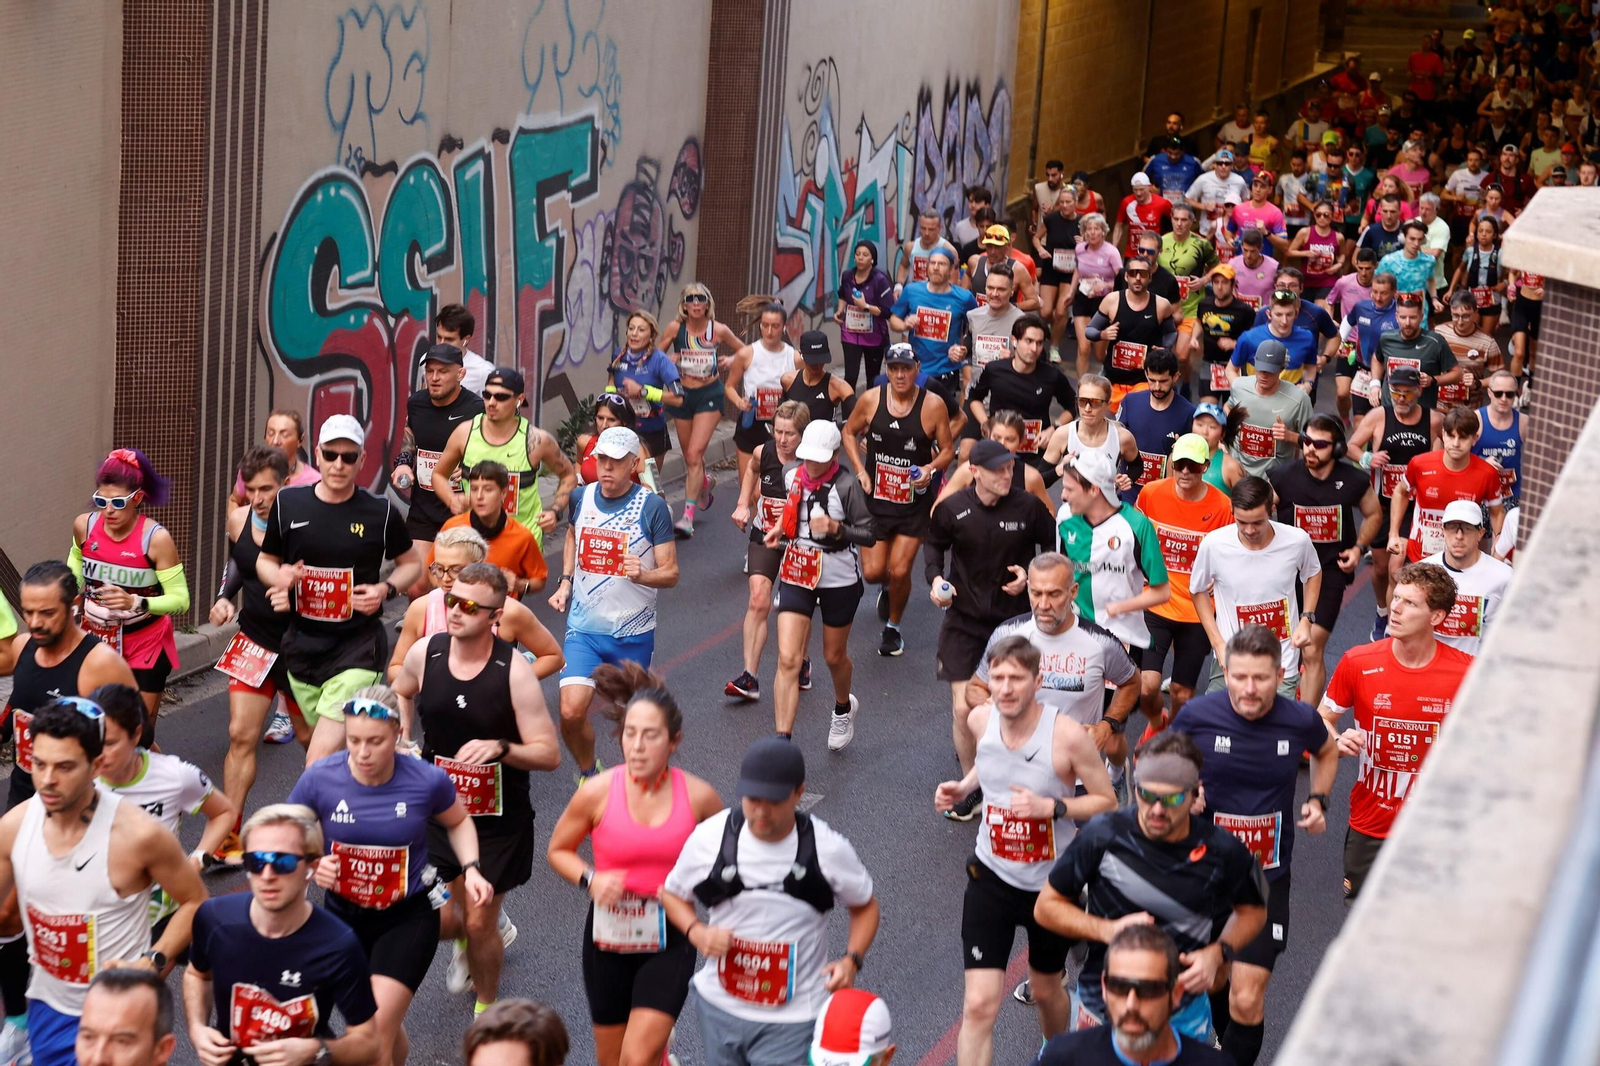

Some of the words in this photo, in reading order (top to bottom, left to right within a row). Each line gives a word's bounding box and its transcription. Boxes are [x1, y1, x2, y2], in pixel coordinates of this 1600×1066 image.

[1246, 432, 1264, 442] 6473
[1386, 432, 1428, 445] TAVISTOCK
[592, 528, 624, 541] GENERALI
[589, 538, 613, 550] 5596
[1165, 539, 1188, 551] 5702
[98, 564, 147, 587] FLOW
[306, 579, 335, 594] 7349
[1249, 602, 1283, 614] GENERALI
[1249, 611, 1275, 625] 2117
[1389, 721, 1431, 733] GENERALI
[1387, 732, 1418, 746] 6151
[449, 773, 480, 788] 9179
[330, 812, 356, 824] ABEL
[1231, 818, 1272, 830] GENERALI
[347, 858, 384, 875] 7010
[733, 951, 772, 973] 4604
